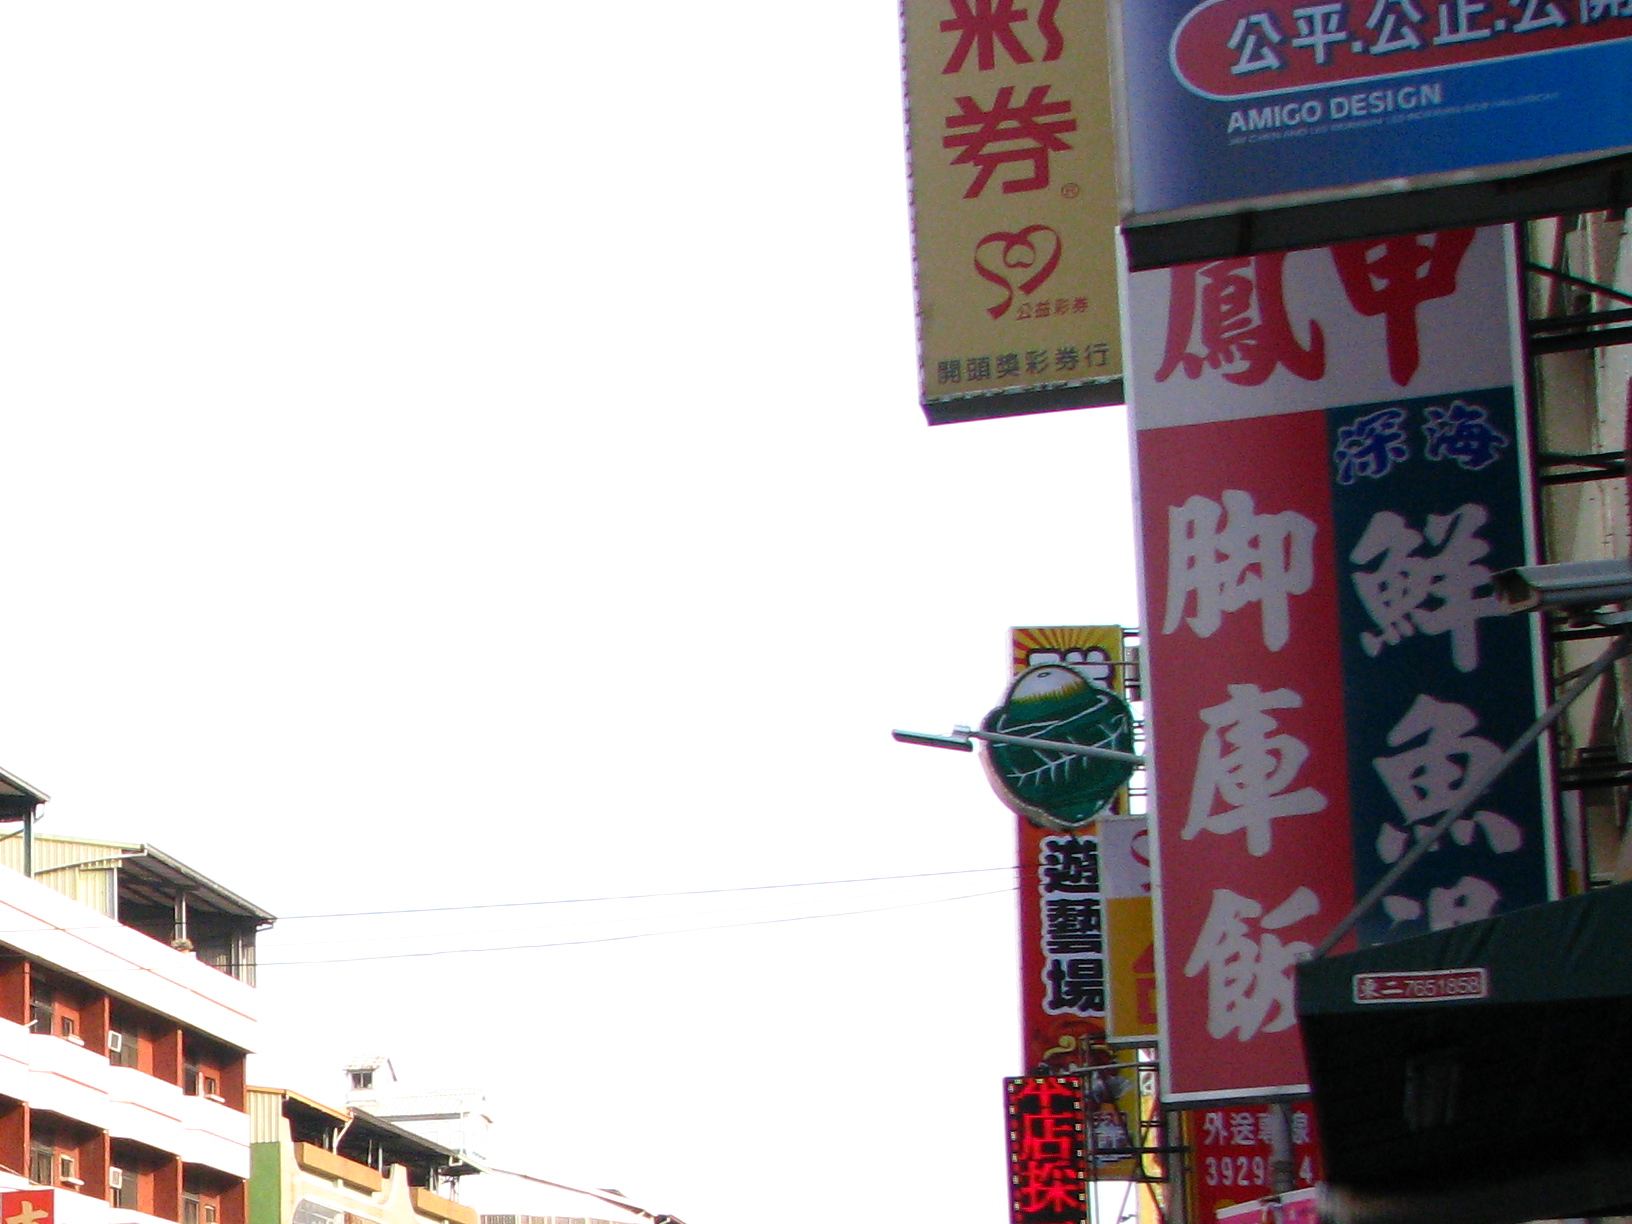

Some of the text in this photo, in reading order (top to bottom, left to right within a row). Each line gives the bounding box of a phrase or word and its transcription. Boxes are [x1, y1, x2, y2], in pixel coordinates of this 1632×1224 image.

[1227, 101, 1322, 134] AMIGO
[1330, 83, 1442, 120] DESIGN
[1015, 297, 1090, 323] 公益彩券
[1205, 1154, 1312, 1188] 39294
